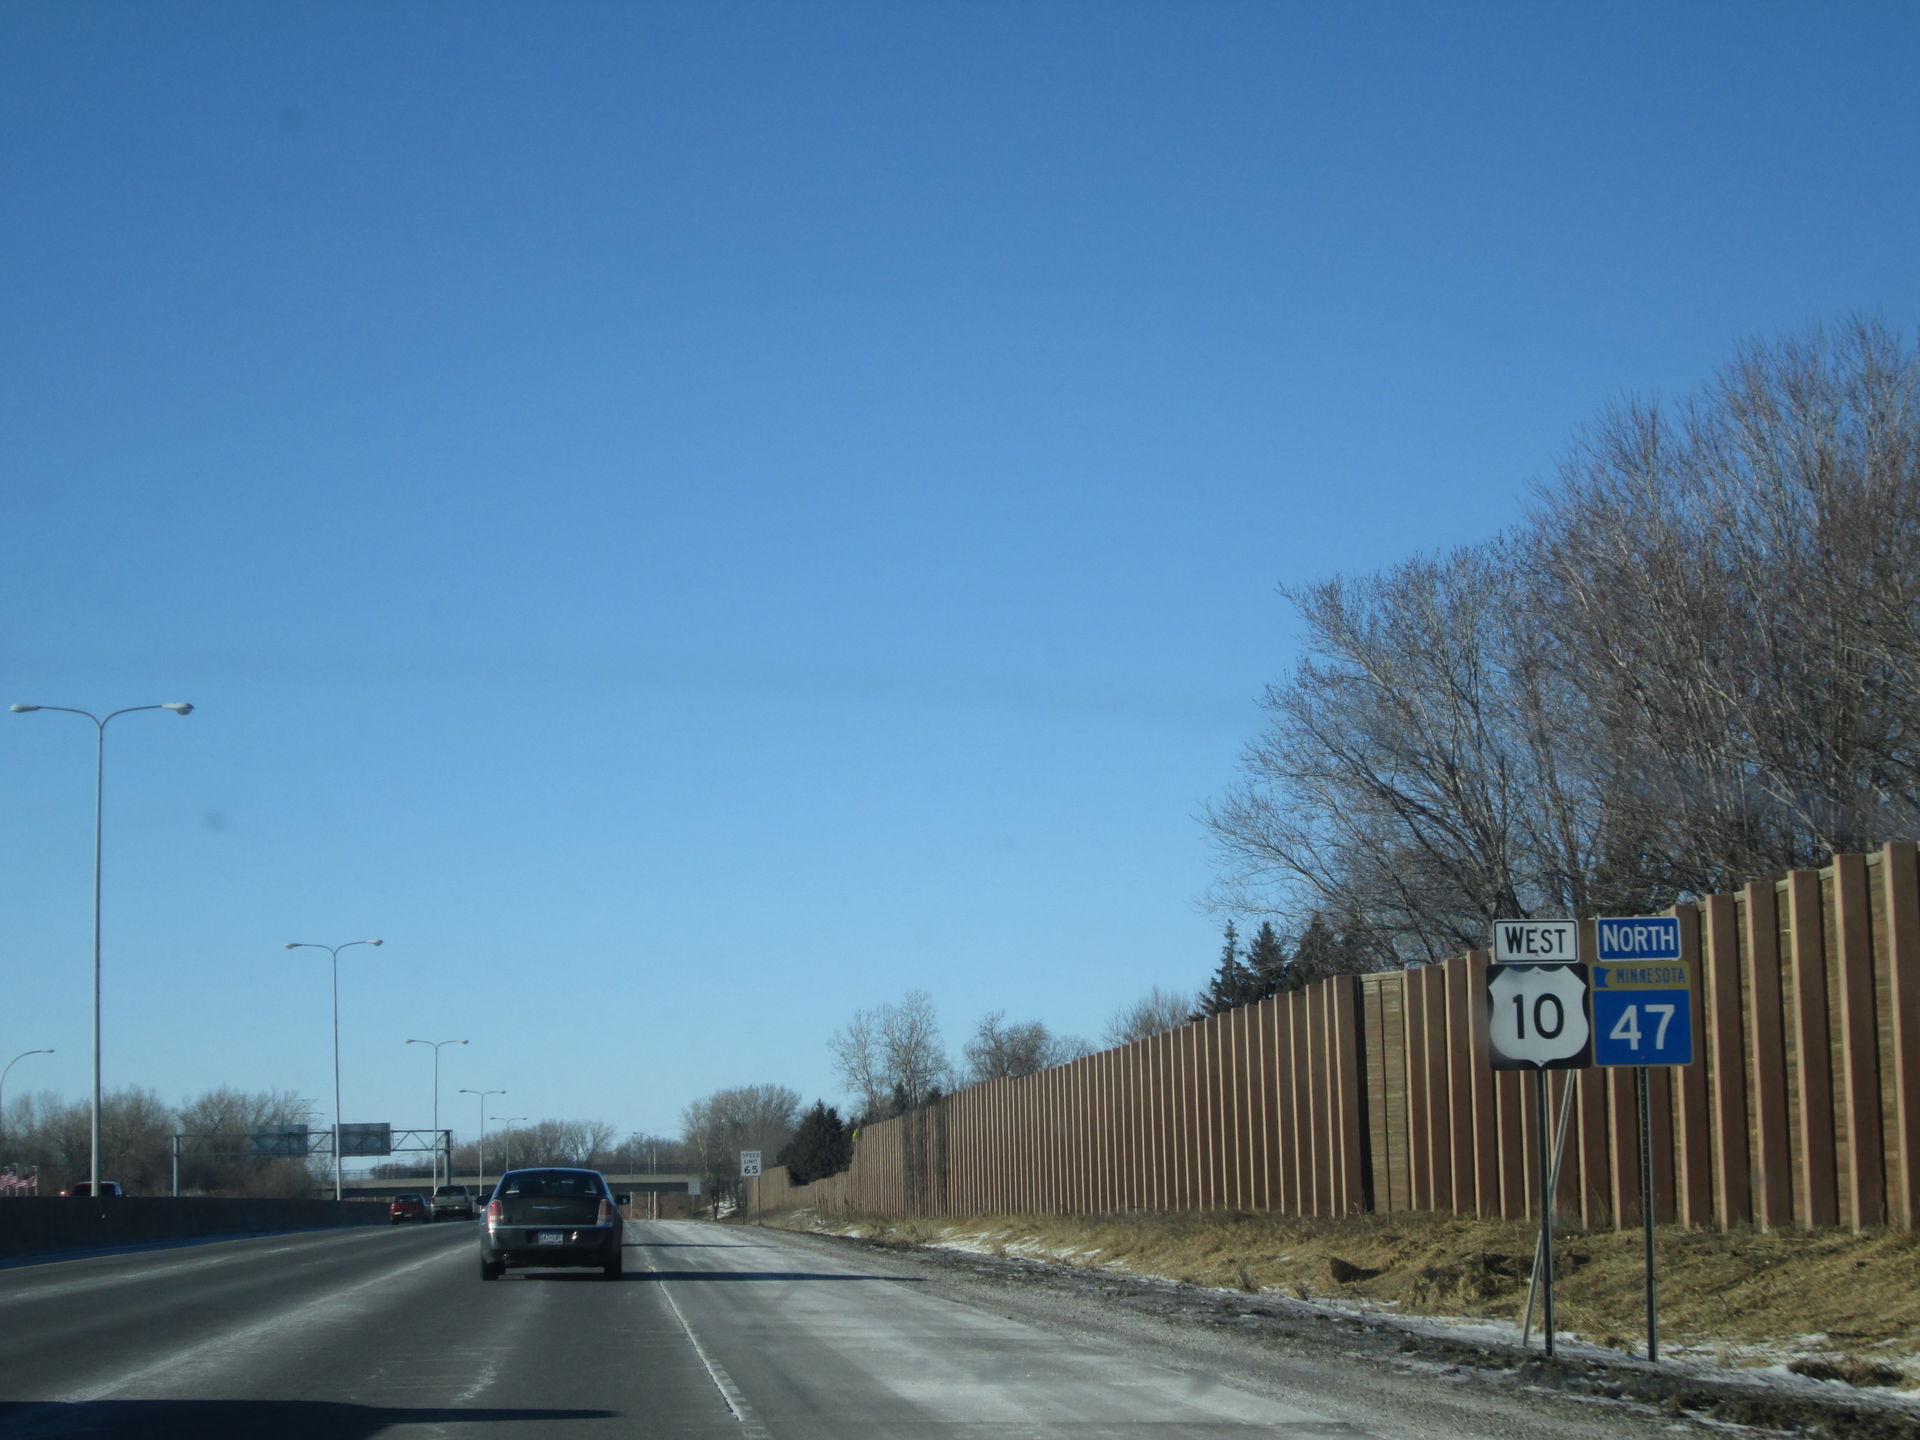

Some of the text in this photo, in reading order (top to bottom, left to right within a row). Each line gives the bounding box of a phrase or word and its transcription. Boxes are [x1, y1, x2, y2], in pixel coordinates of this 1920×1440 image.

[1505, 926, 1566, 954] WEST
[1603, 924, 1674, 952] NORTH
[1616, 968, 1685, 984] MINNESOTA
[1512, 993, 1564, 1039] 10
[1610, 1004, 1675, 1050] 47
[744, 1165, 758, 1174] 65
